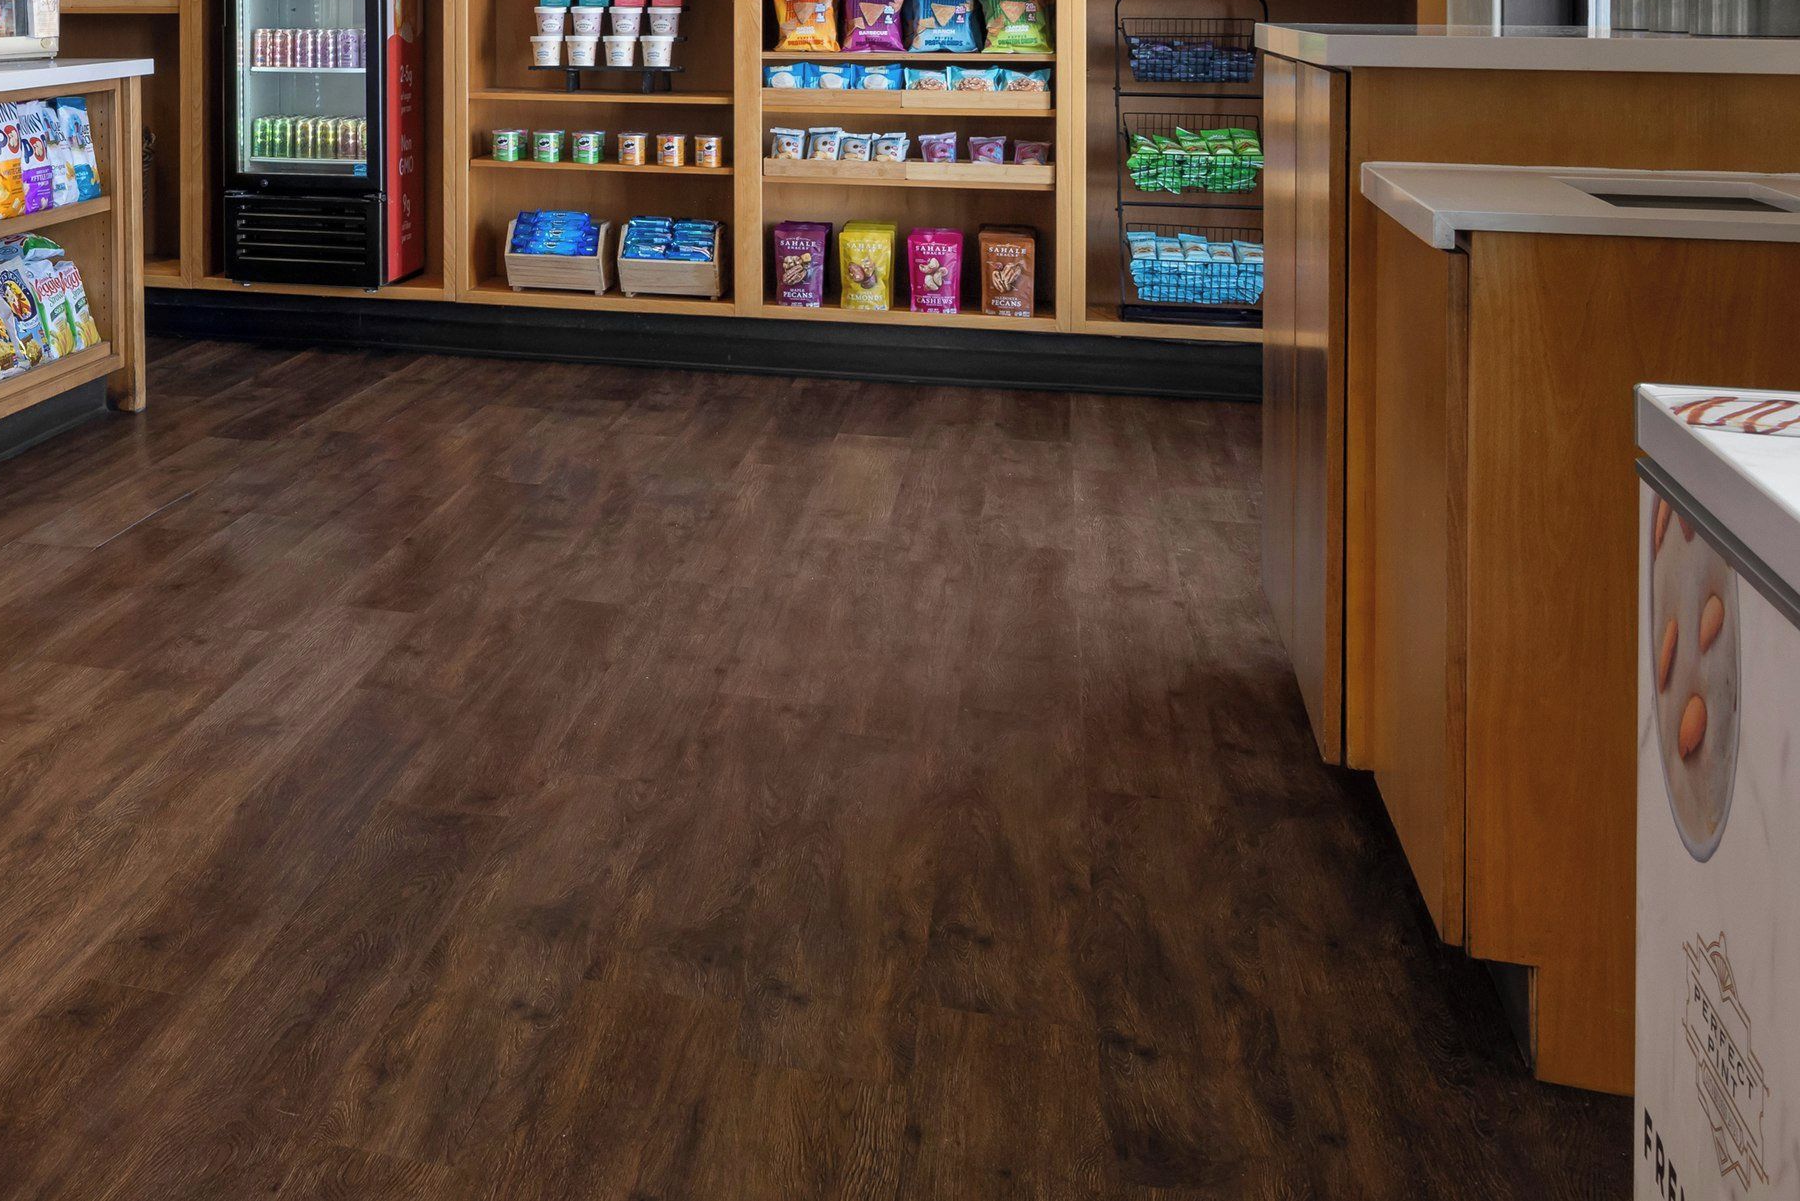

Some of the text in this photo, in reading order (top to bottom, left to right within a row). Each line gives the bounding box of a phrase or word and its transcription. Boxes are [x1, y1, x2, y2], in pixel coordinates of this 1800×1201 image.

[858, 29, 889, 37] BARBECUE
[780, 239, 817, 248] SAHALE
[916, 245, 953, 253] SAHALE
[989, 246, 1027, 254] SAHALE
[783, 291, 813, 299] PECANS
[916, 297, 953, 305] CASHEWS
[991, 300, 1022, 308] PECANS
[1694, 984, 1754, 1100] PERFECT
[1708, 1034, 1738, 1098] PINT
[1644, 1106, 1686, 1201] FRE
